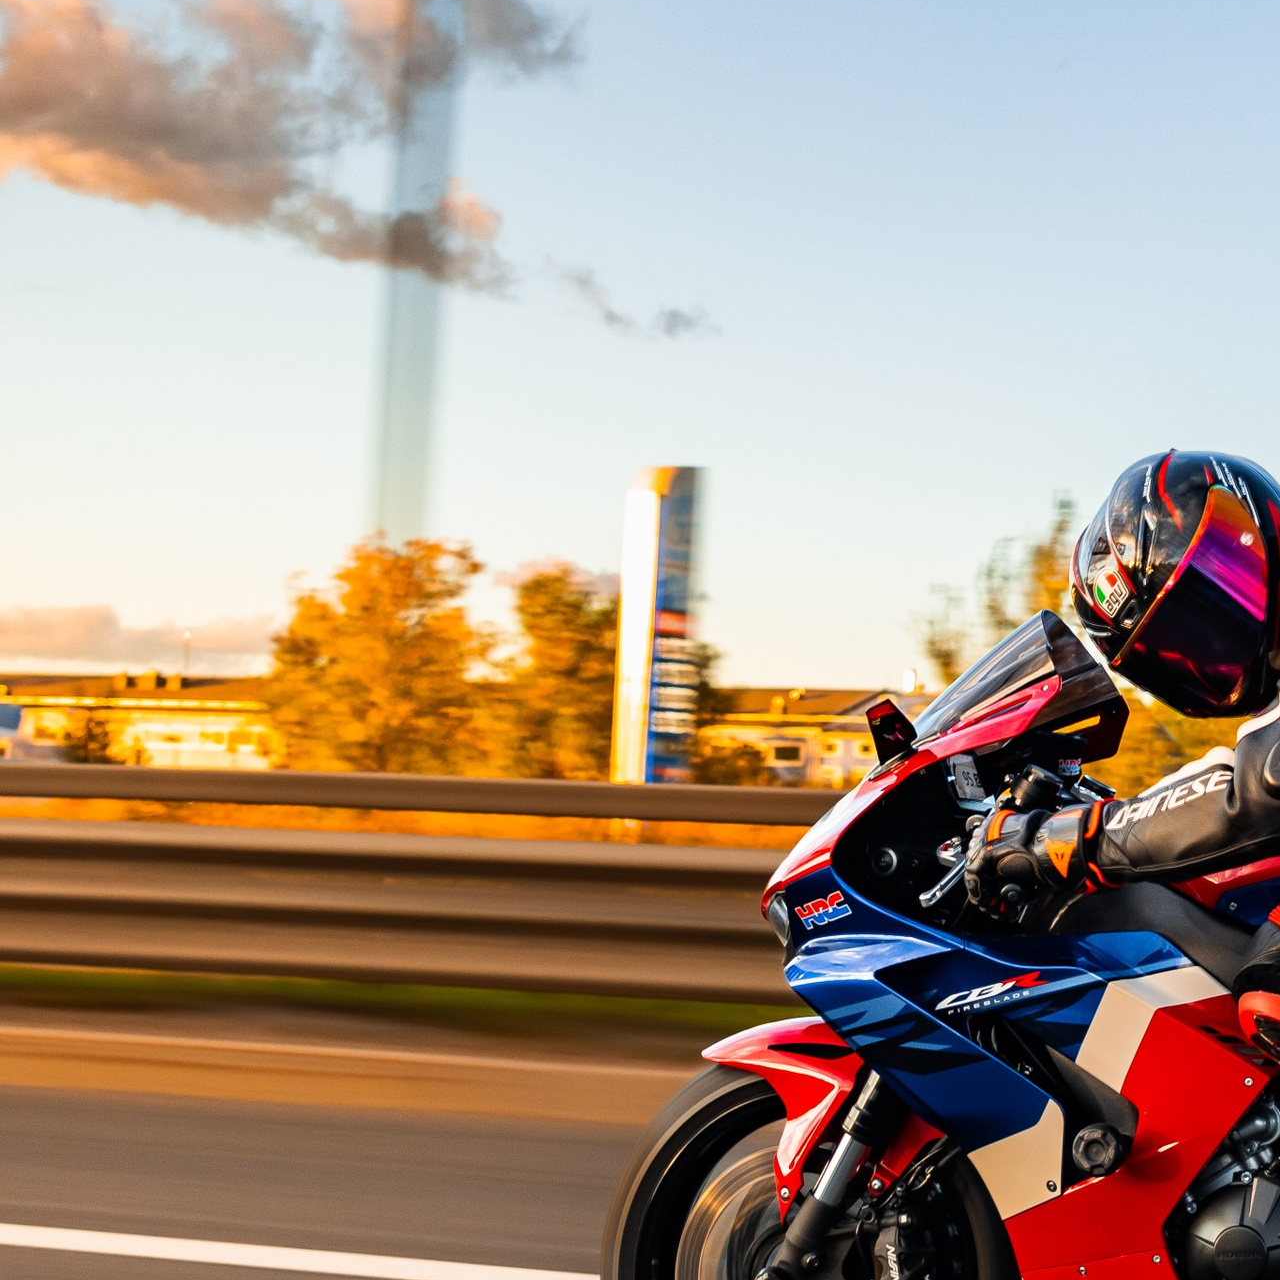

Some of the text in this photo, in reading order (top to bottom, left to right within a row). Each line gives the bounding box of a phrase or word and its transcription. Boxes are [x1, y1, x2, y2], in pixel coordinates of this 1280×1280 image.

[1105, 771, 1234, 830] DAINESE
[794, 890, 853, 930] HRC
[948, 990, 1030, 1015] FIREBLADE
